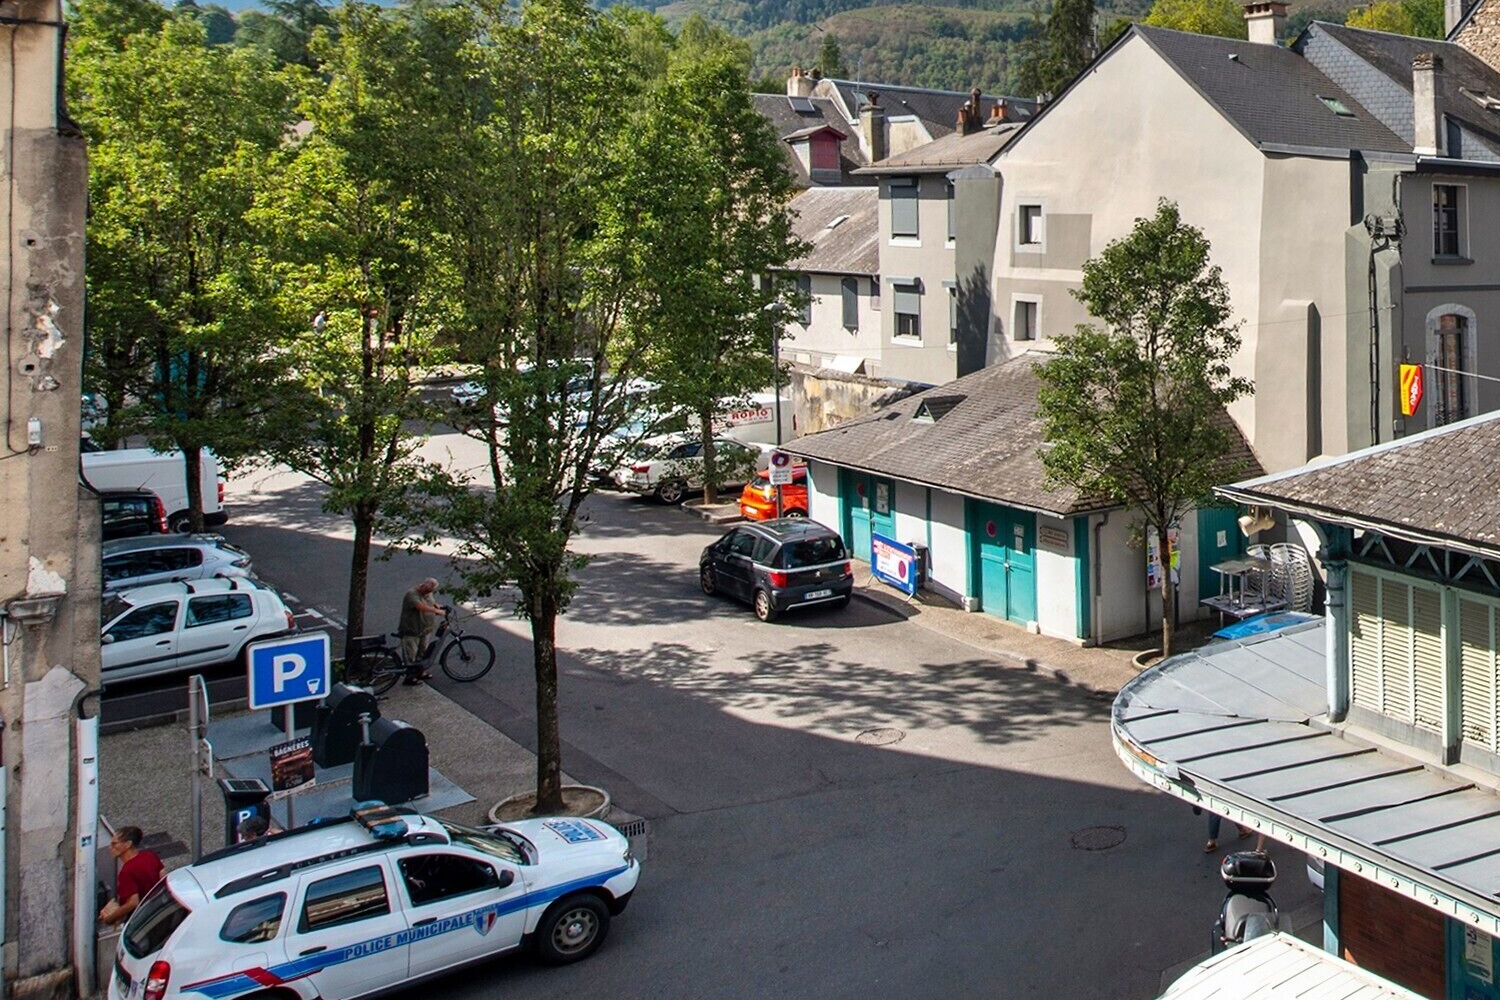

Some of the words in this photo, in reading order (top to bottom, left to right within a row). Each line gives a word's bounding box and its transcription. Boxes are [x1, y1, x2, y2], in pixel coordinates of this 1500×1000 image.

[273, 653, 307, 694] P
[239, 811, 251, 823] P
[344, 936, 392, 960] POLICE
[397, 913, 473, 945] MUNICIPALE
